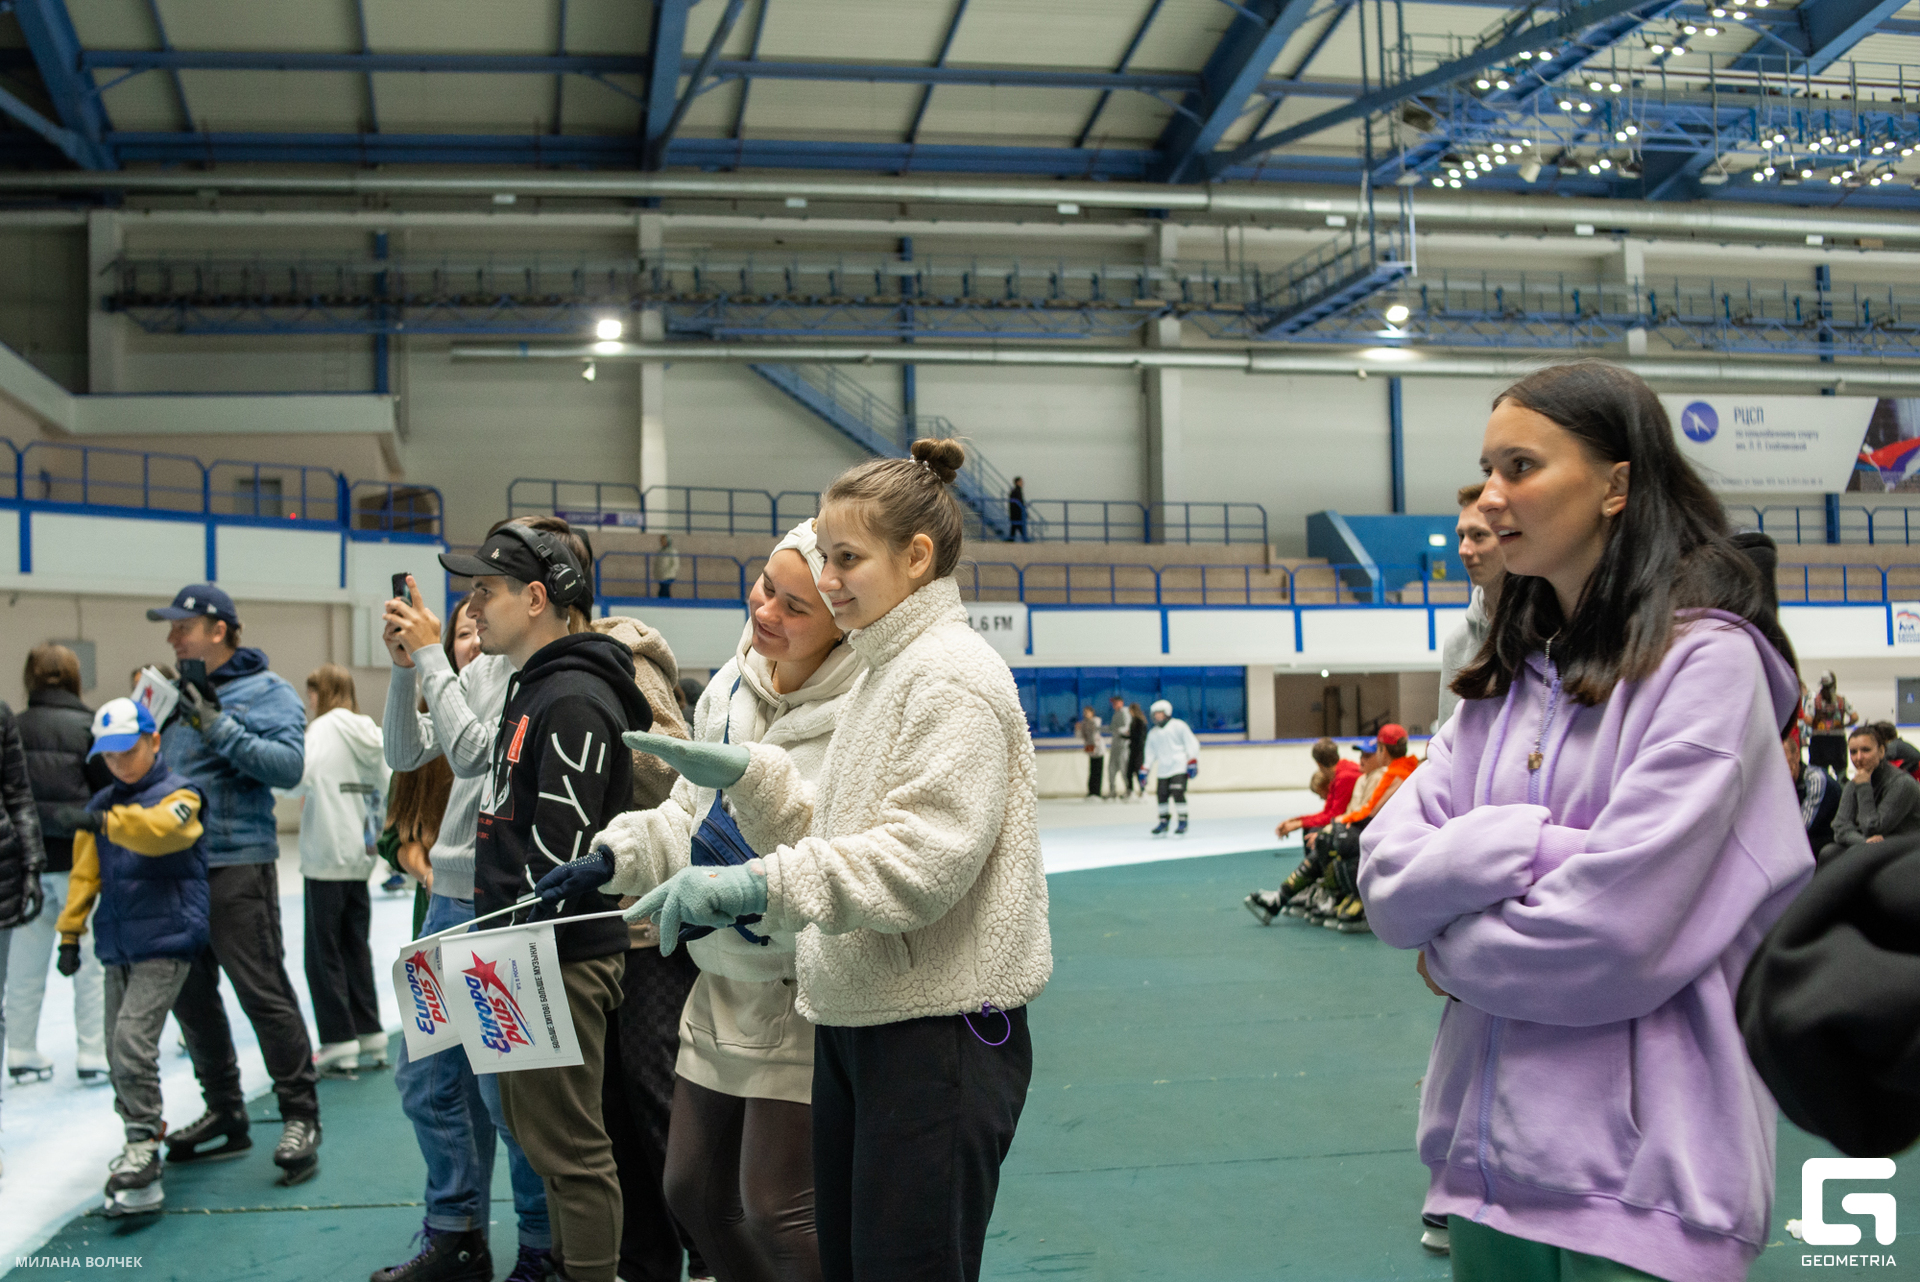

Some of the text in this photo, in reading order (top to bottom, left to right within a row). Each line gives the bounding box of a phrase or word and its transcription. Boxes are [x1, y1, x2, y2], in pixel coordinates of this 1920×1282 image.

[1733, 406, 1765, 426] РЦСП
[994, 616, 1013, 631] FM
[464, 975, 512, 1054] Europa
[529, 942, 560, 1049] БОЛЬШЕ ХИТОВ! БОЛЬШЕ МУЗЫКИ!
